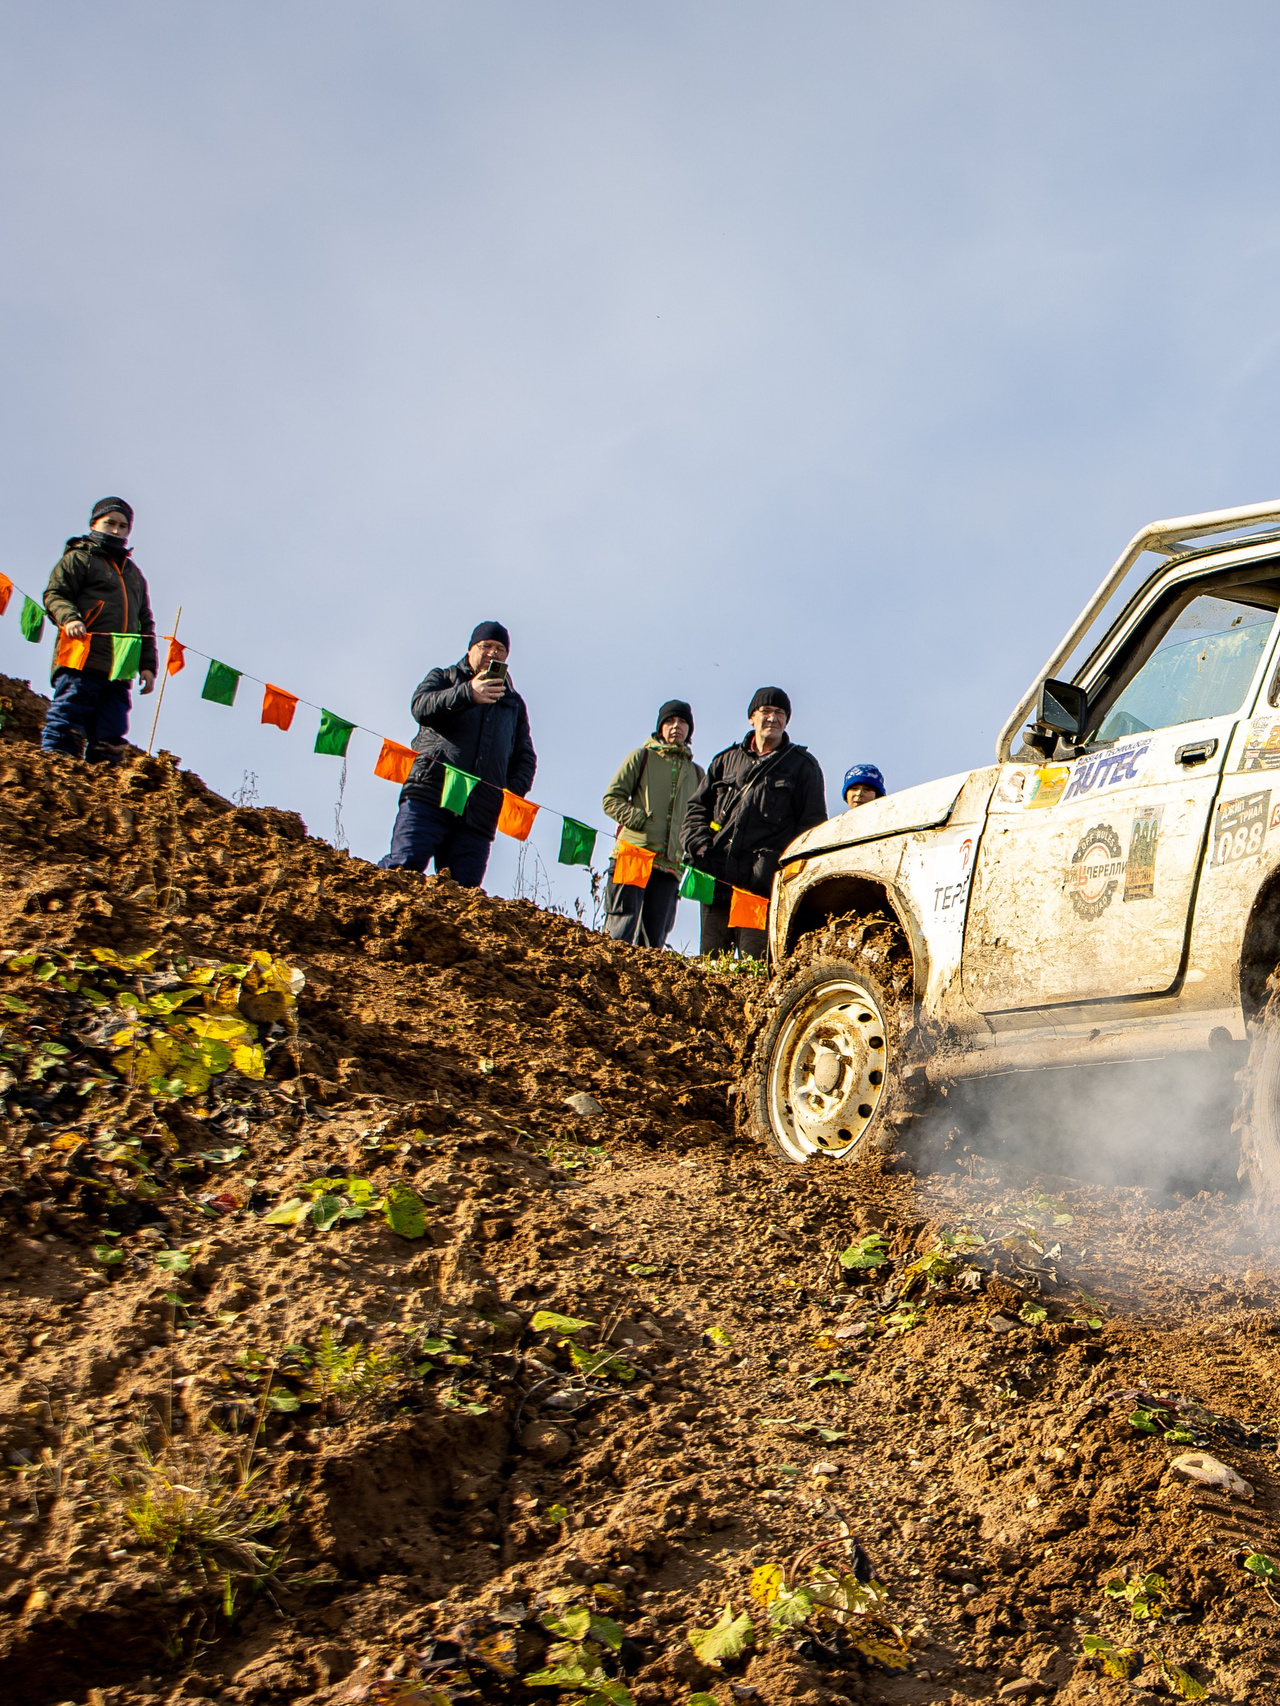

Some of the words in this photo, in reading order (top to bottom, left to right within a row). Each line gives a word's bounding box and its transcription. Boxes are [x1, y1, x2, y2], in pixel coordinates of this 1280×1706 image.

[1063, 745, 1149, 802] RUTEC
[1239, 804, 1263, 823] ТРИАЛ
[1081, 835, 1094, 850] OFF
[1096, 831, 1115, 847] RULES
[1217, 822, 1263, 864] 088
